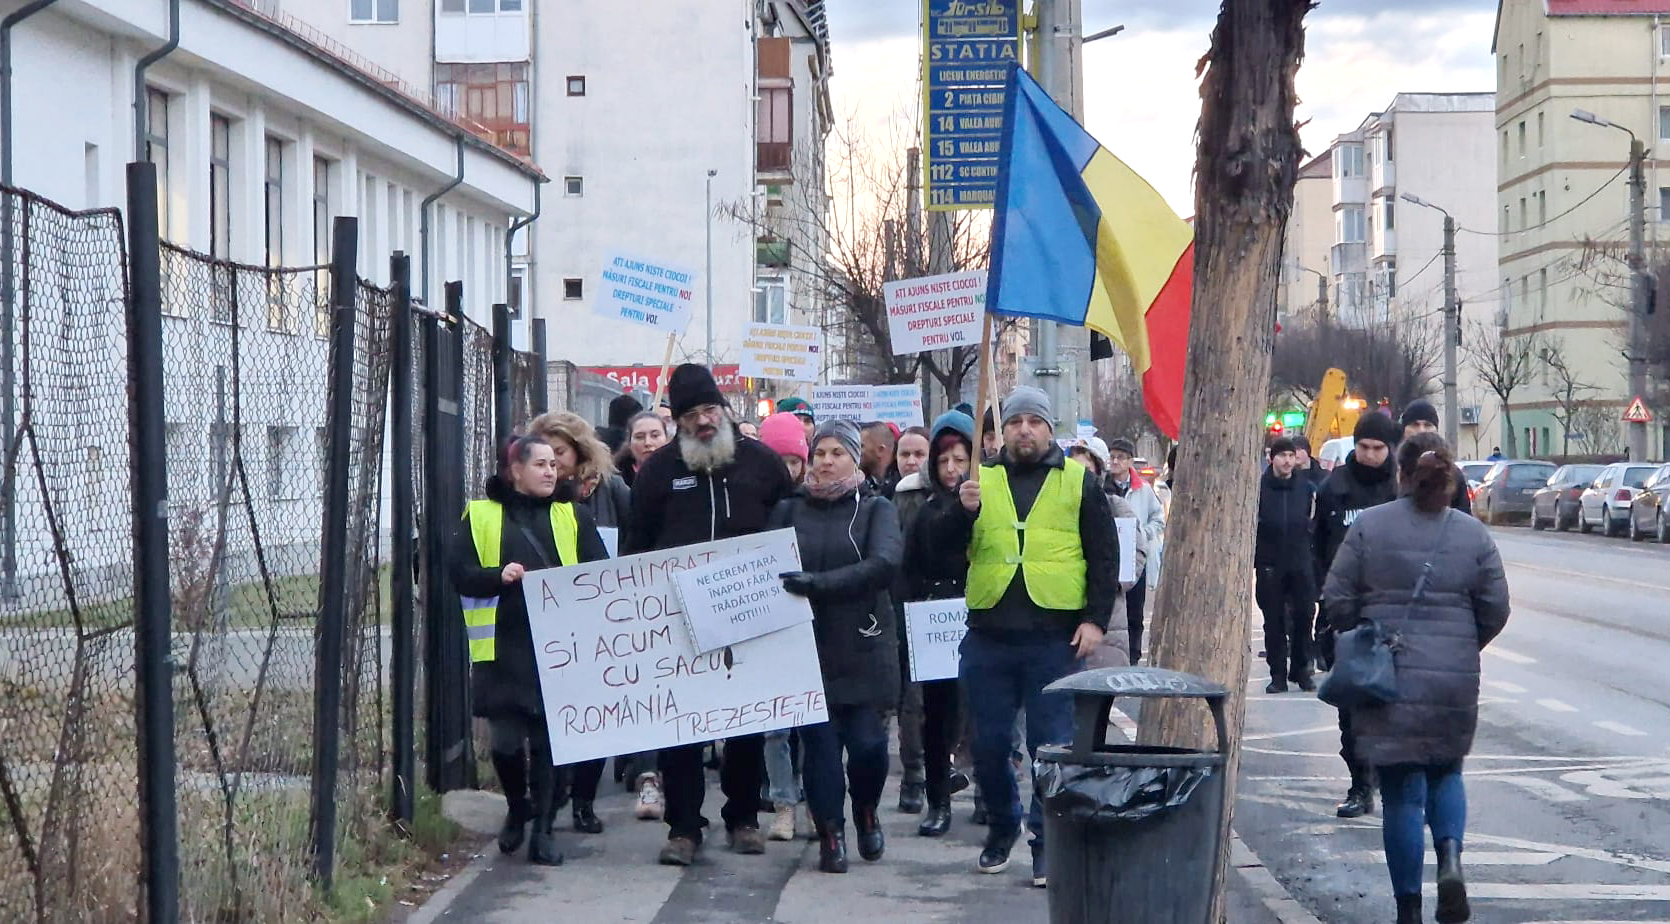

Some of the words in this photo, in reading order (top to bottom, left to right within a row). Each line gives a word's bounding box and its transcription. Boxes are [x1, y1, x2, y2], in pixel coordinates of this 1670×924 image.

[931, 43, 1015, 59] STATIA
[939, 70, 964, 81] LICEUL
[944, 91, 954, 108] 2
[938, 116, 954, 132] 14
[959, 117, 983, 129] VALEA
[937, 140, 954, 156] 15
[959, 141, 983, 153] VALEA
[984, 141, 1000, 153] AUR
[930, 164, 954, 180] 112
[959, 165, 970, 178] SC
[930, 189, 954, 205] 114
[624, 259, 644, 272] AJUNS
[664, 269, 688, 284] CIOCOI
[627, 276, 653, 291] FISCALE
[654, 282, 679, 297] PENTRU
[679, 289, 692, 301] NOI
[907, 284, 930, 297] AJUNS
[952, 277, 978, 291] CIOCOI
[612, 288, 645, 305] DREPTURI
[645, 297, 675, 312] SPECIALE
[917, 298, 946, 312] FISCALE
[946, 295, 974, 309] PENTRU
[974, 293, 986, 304] NO
[620, 306, 645, 321] PENTRU
[907, 317, 942, 331] DREPTURI
[943, 312, 976, 326] SPECIALE
[922, 333, 949, 346] PENTRU
[606, 371, 649, 387] Sala
[696, 575, 712, 587] NE
[712, 563, 748, 582] CEREM
[707, 581, 745, 600] ÎNAPOI
[746, 570, 774, 587] FĂRĂ
[541, 579, 560, 612] A
[711, 590, 769, 614] TRĂDĂTORI
[605, 593, 682, 623] CIOL
[595, 625, 672, 662] ACUM
[926, 629, 964, 643] TREZE
[603, 663, 640, 687] CU
[558, 684, 678, 736] ROMÂNIA
